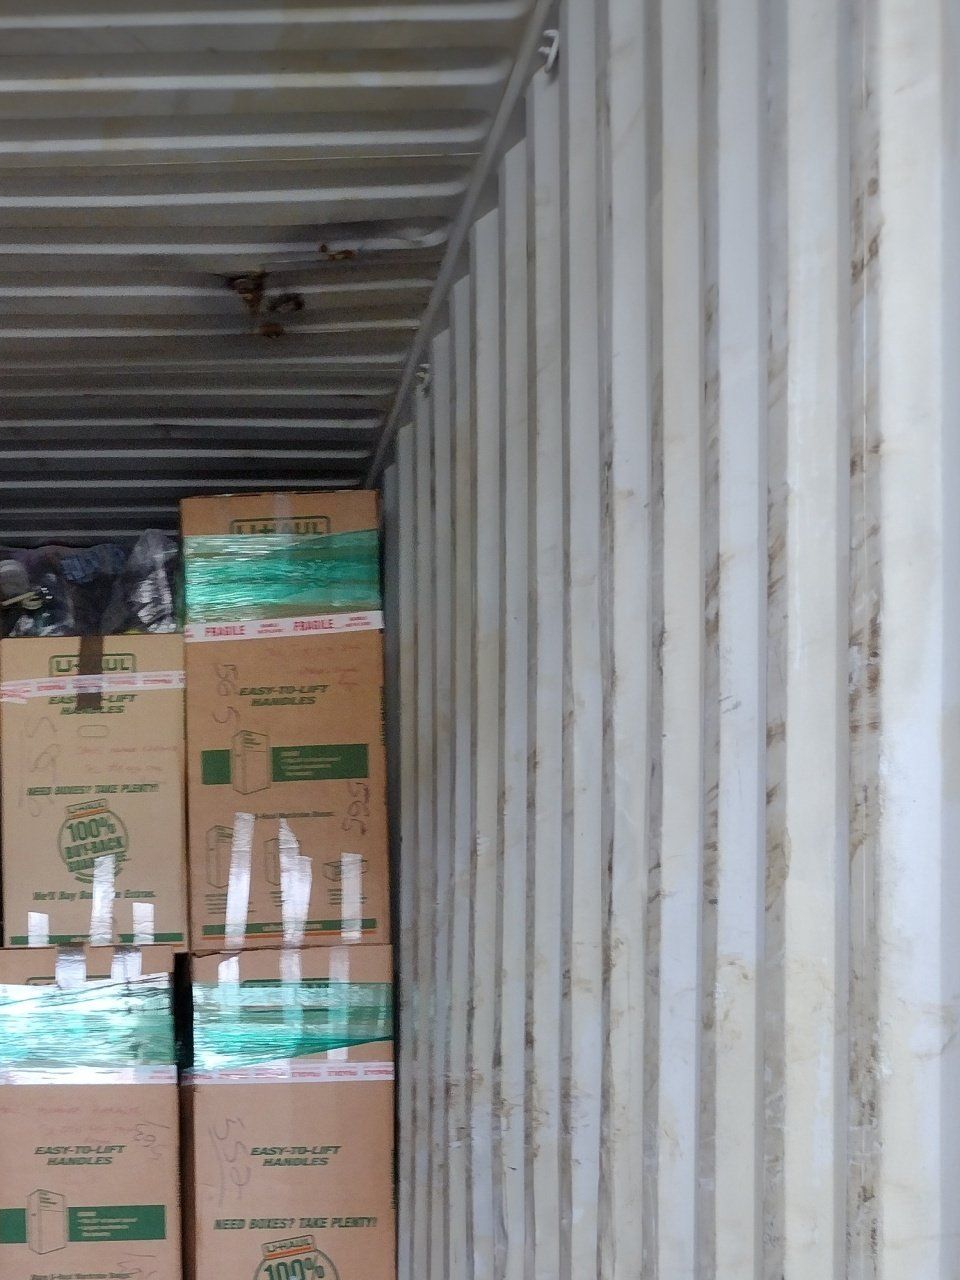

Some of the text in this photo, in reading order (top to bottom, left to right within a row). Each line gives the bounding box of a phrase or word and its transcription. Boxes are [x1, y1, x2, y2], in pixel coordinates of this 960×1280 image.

[34, 1145, 127, 1155] EASY-TO-LIFT
[250, 1145, 342, 1156] EASY-TO-LIFT
[47, 1156, 113, 1166] HANDLES
[262, 1157, 329, 1167] HANDLES
